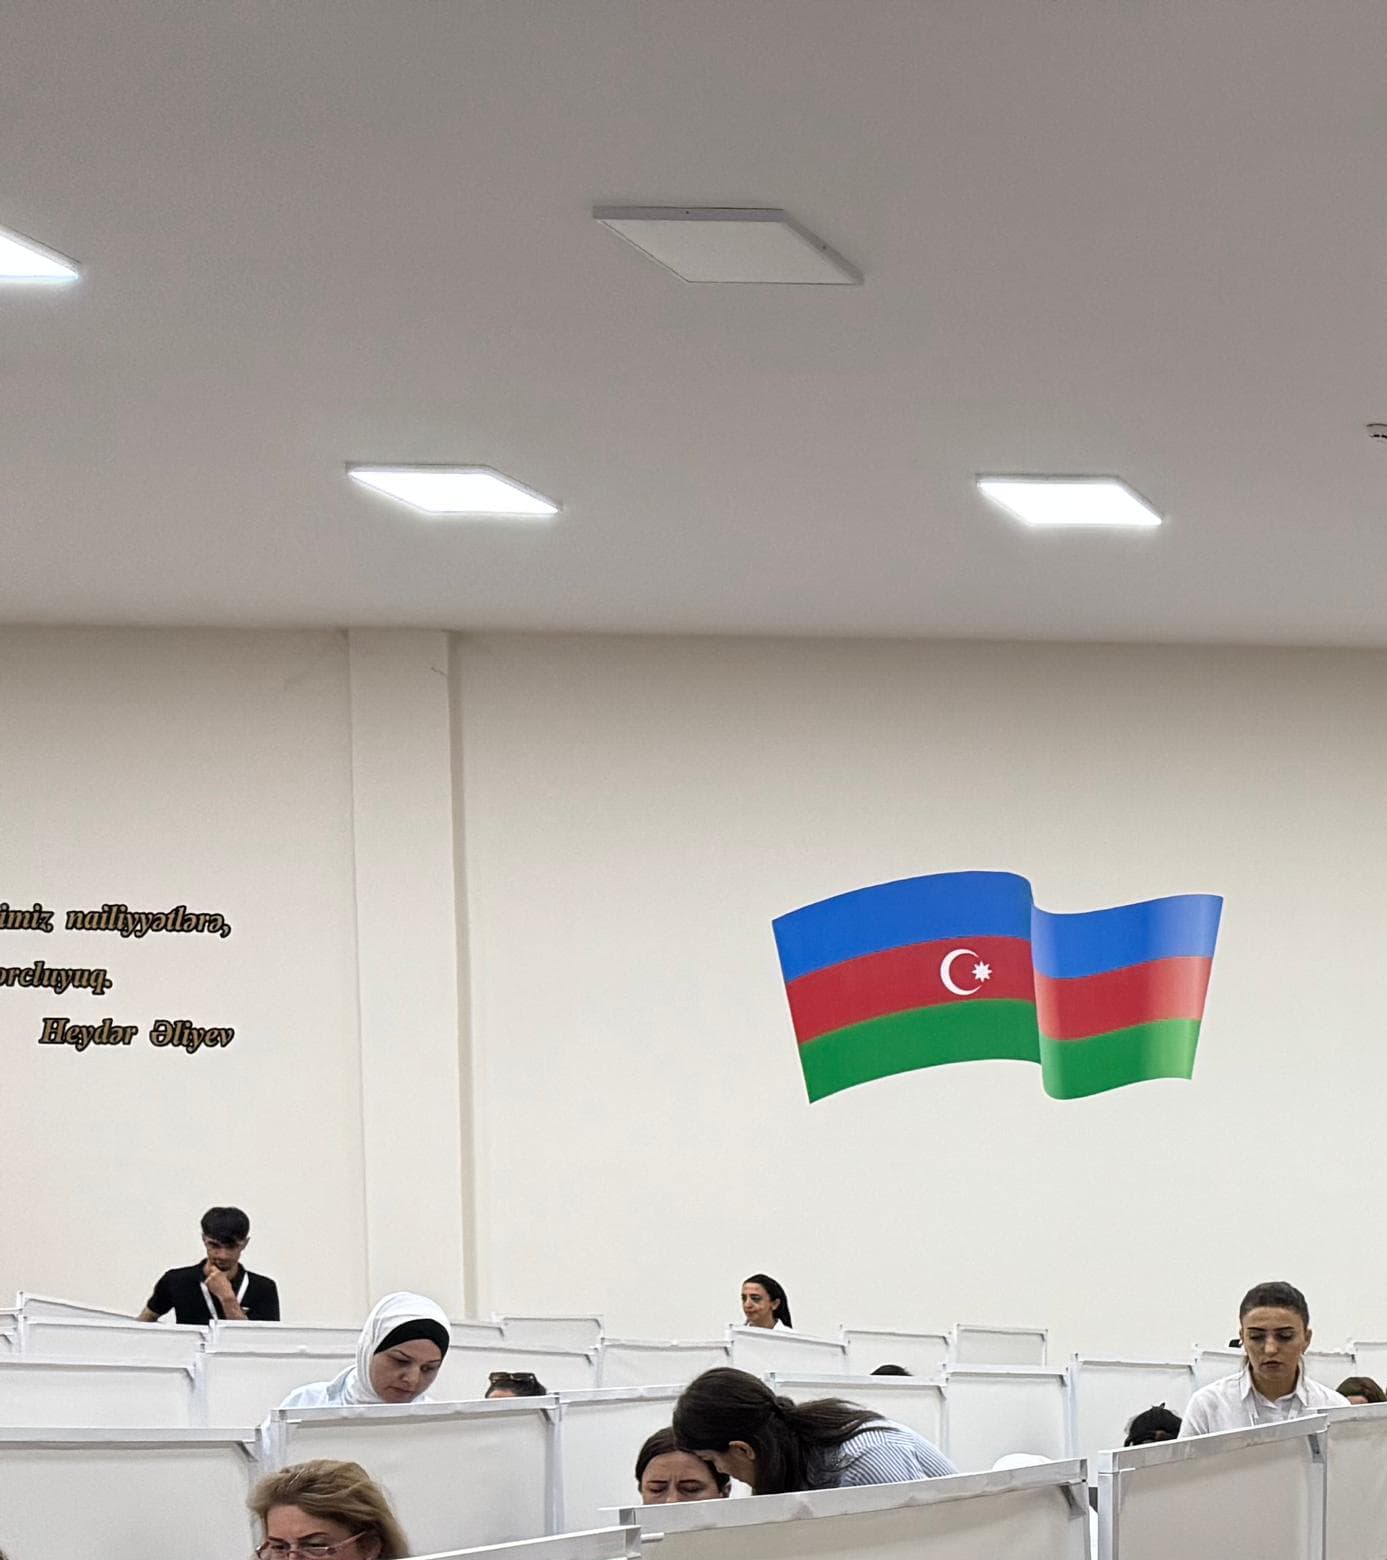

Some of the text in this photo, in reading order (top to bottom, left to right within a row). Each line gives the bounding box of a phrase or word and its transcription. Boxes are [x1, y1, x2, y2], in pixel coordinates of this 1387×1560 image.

[65, 904, 231, 938] nailiyyətlərə,
[38, 1018, 234, 1054] Heydər Əliyev
